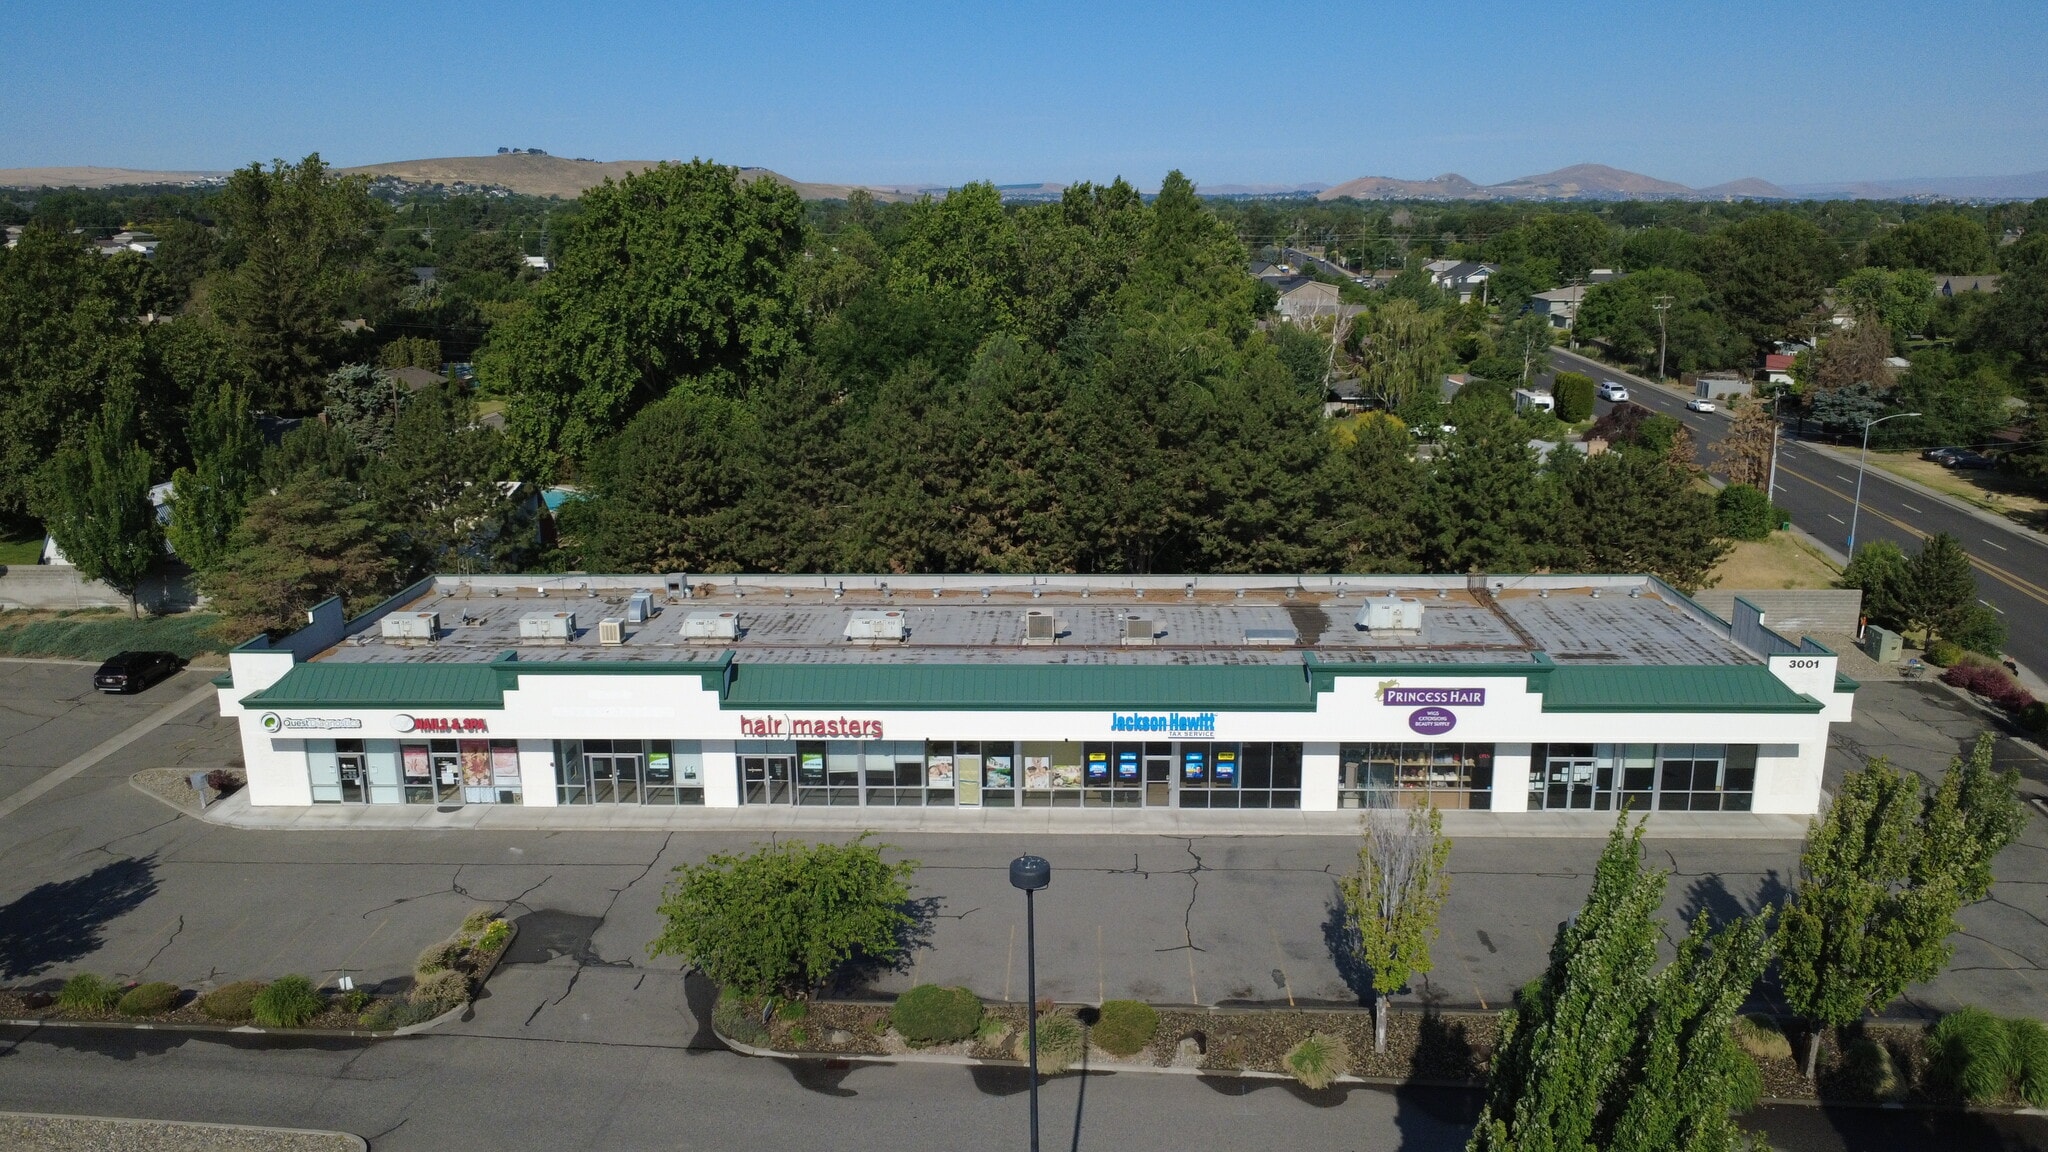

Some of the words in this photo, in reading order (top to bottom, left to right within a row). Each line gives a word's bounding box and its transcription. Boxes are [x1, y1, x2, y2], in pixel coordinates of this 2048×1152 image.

[1789, 660, 1819, 669] 3001
[1387, 690, 1448, 703] PRINCESS
[1450, 691, 1481, 703] HAIR
[414, 718, 449, 731] NAILS
[463, 718, 487, 731] SPA
[740, 714, 783, 736] hair
[793, 715, 883, 739] masters
[1111, 713, 1167, 732] Jackson
[1169, 713, 1215, 731] Hewitt
